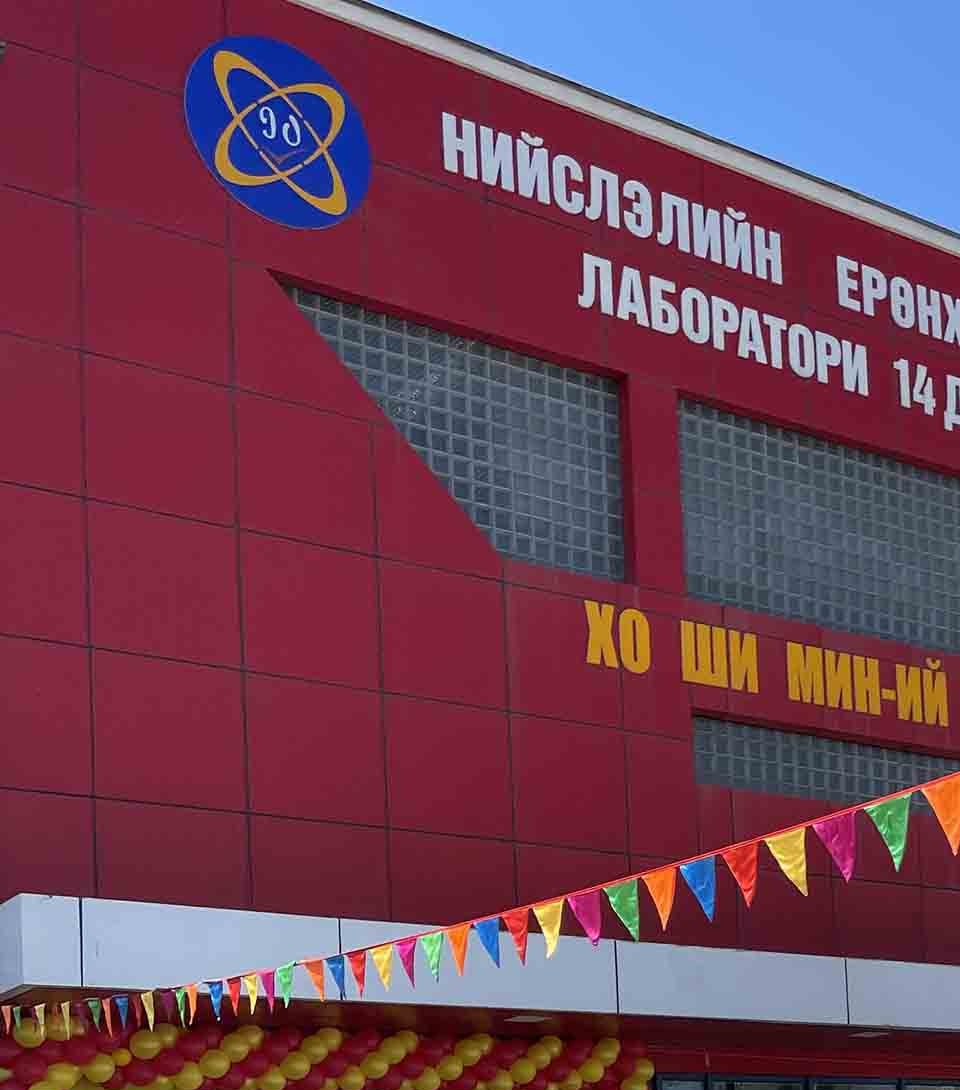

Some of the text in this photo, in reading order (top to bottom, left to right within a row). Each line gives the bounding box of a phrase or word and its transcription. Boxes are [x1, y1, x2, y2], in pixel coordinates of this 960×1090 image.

[442, 111, 785, 285] НИЙСЛЭЛИЙН
[577, 252, 869, 397] ЛАБОРАТОРИ
[893, 358, 937, 416] 14
[584, 599, 652, 674] ХО
[680, 619, 760, 694] ШИ
[787, 641, 949, 727] МИН-ИЙ
